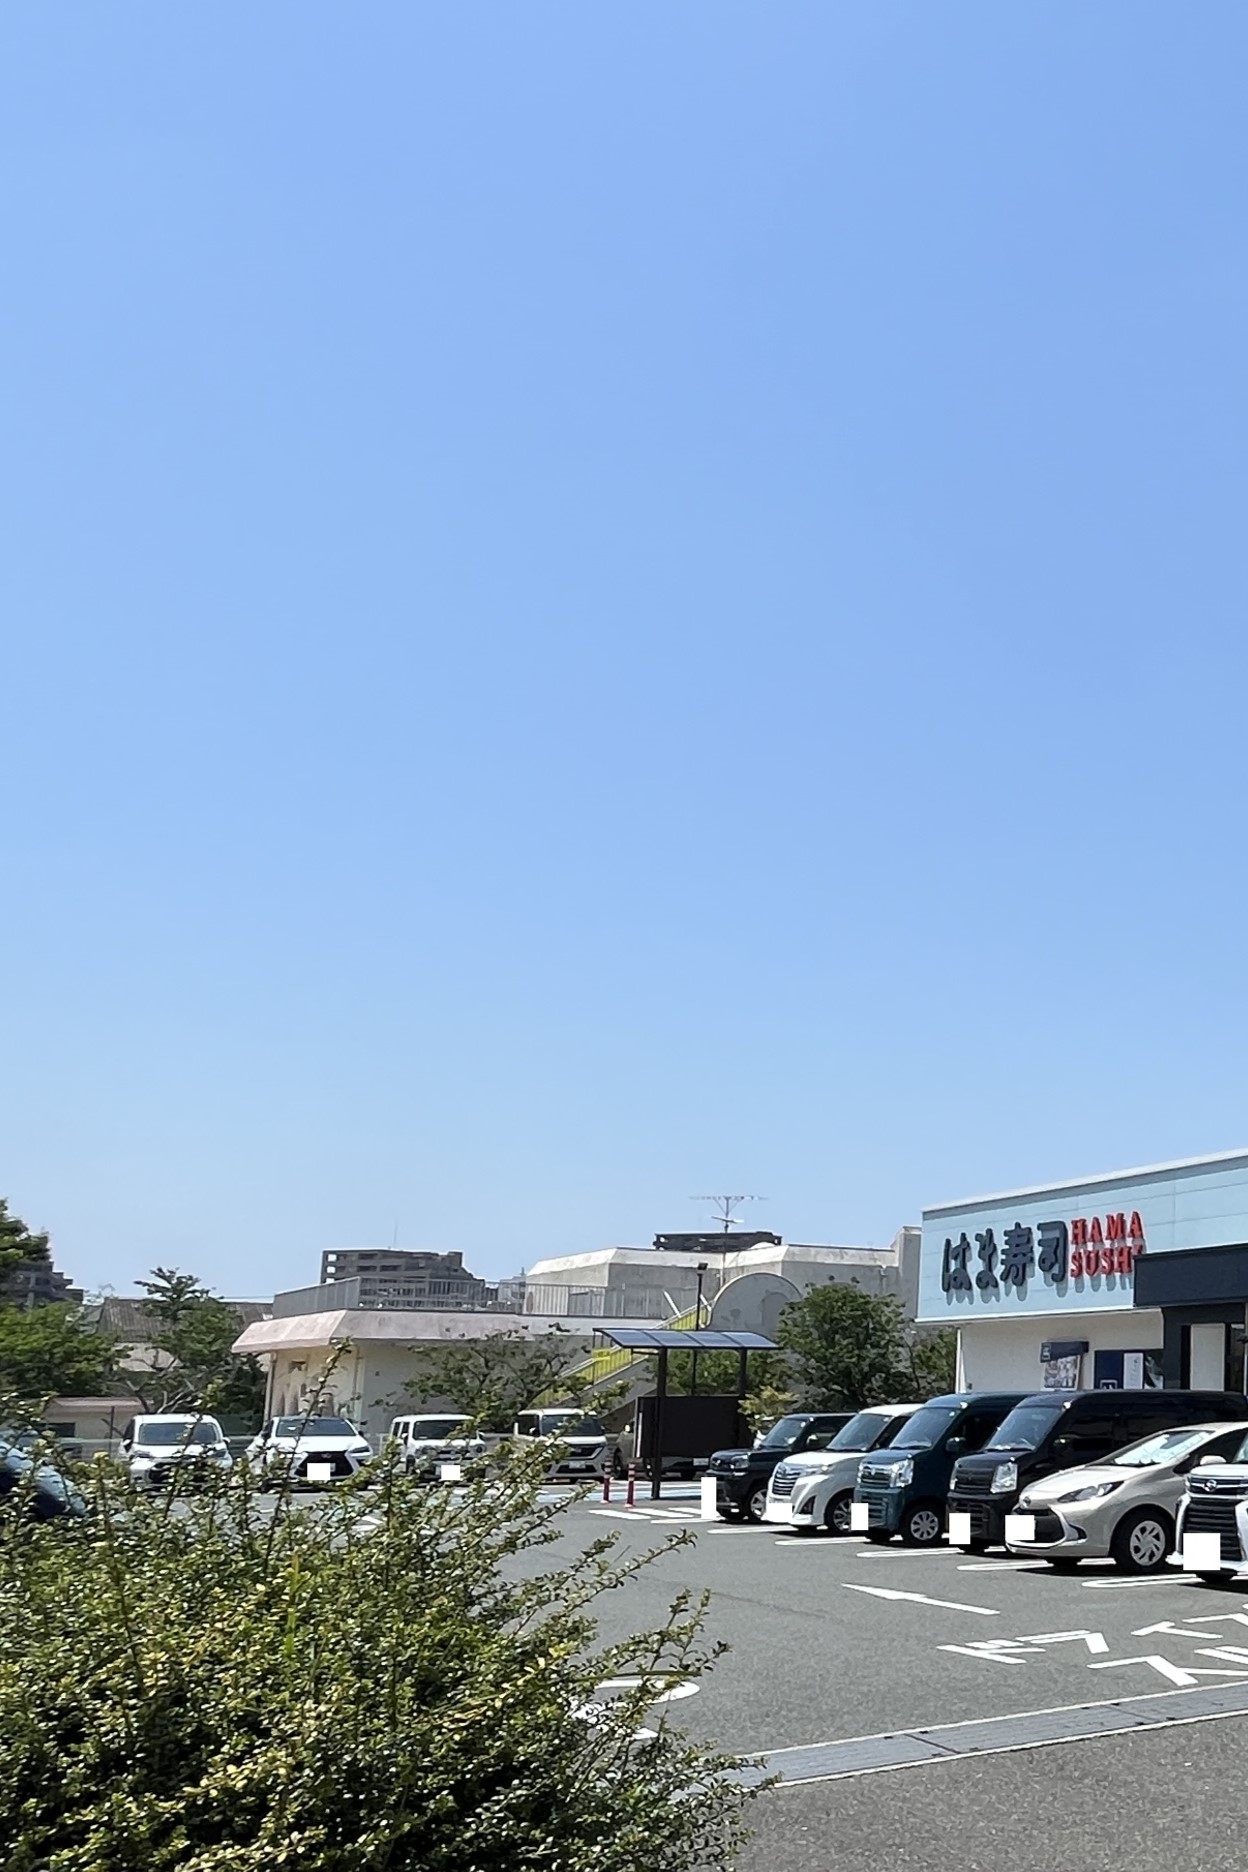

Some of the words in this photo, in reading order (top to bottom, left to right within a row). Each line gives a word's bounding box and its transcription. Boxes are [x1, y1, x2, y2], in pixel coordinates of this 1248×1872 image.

[1070, 1211, 1144, 1246] HAMA
[941, 1221, 1069, 1293] はま寿司
